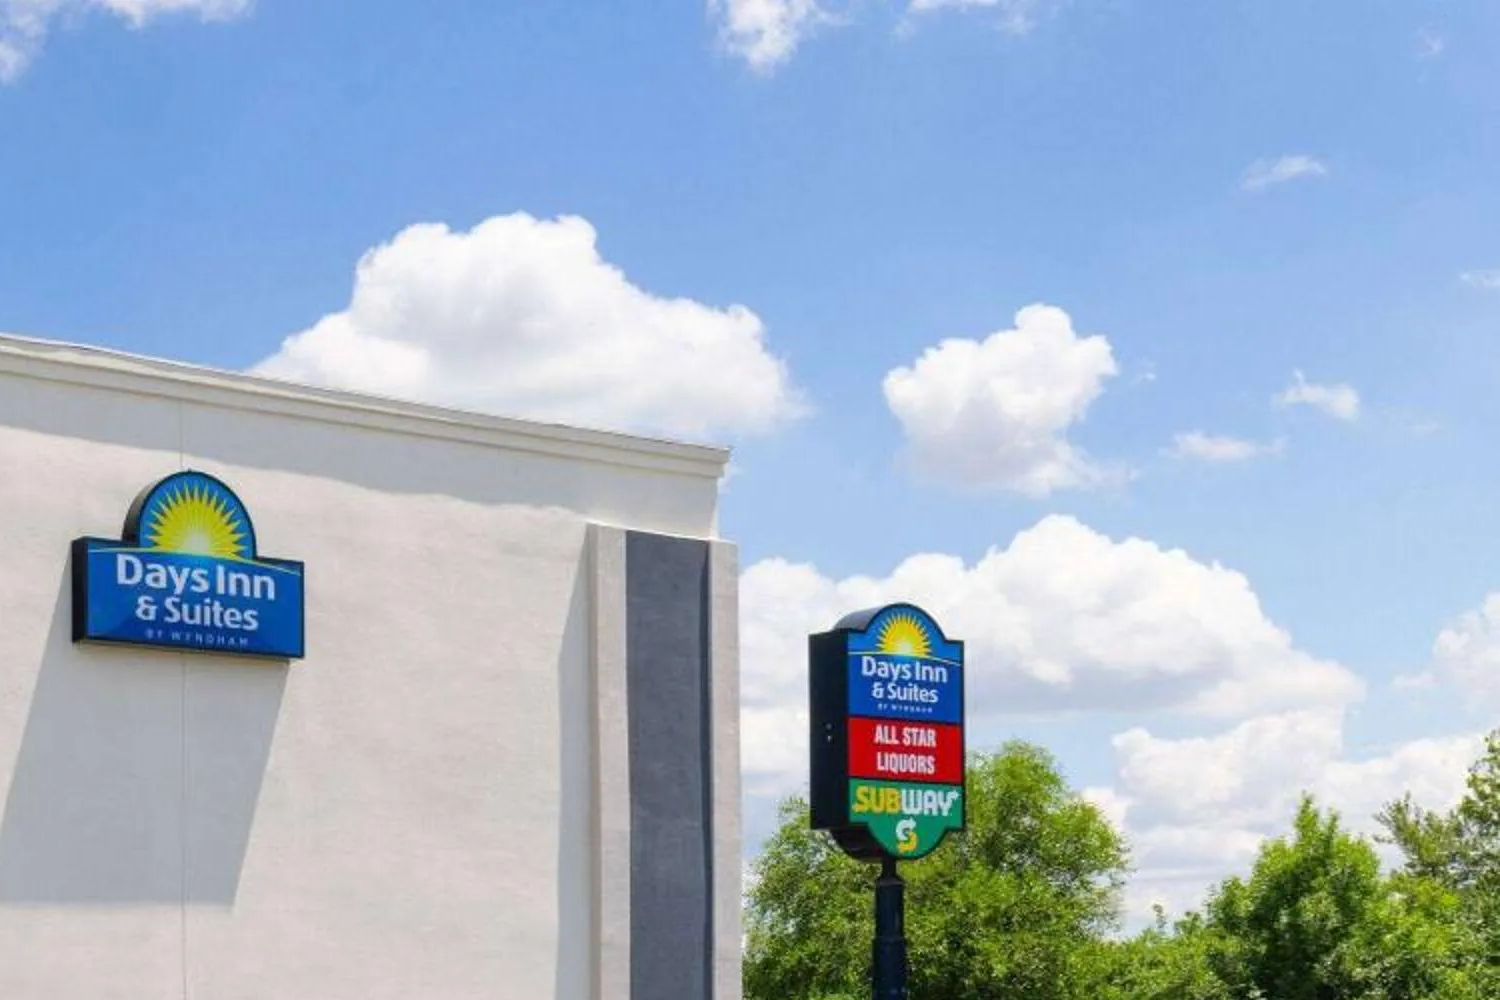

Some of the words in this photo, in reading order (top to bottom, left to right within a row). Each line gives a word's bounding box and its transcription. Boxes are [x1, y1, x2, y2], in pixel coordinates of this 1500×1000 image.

[116, 553, 210, 595] Days
[216, 564, 276, 601] Inn
[135, 595, 158, 621] &
[164, 596, 260, 631] Suites
[171, 629, 249, 646] WYNDHAM
[861, 655, 912, 682] Days
[915, 661, 948, 684] Inn
[872, 681, 885, 699] &
[887, 682, 940, 703] Suites
[873, 723, 899, 745] ALL
[902, 726, 937, 749] STAR
[877, 751, 936, 775] LIQUORS
[852, 785, 960, 817] SUBWAY
